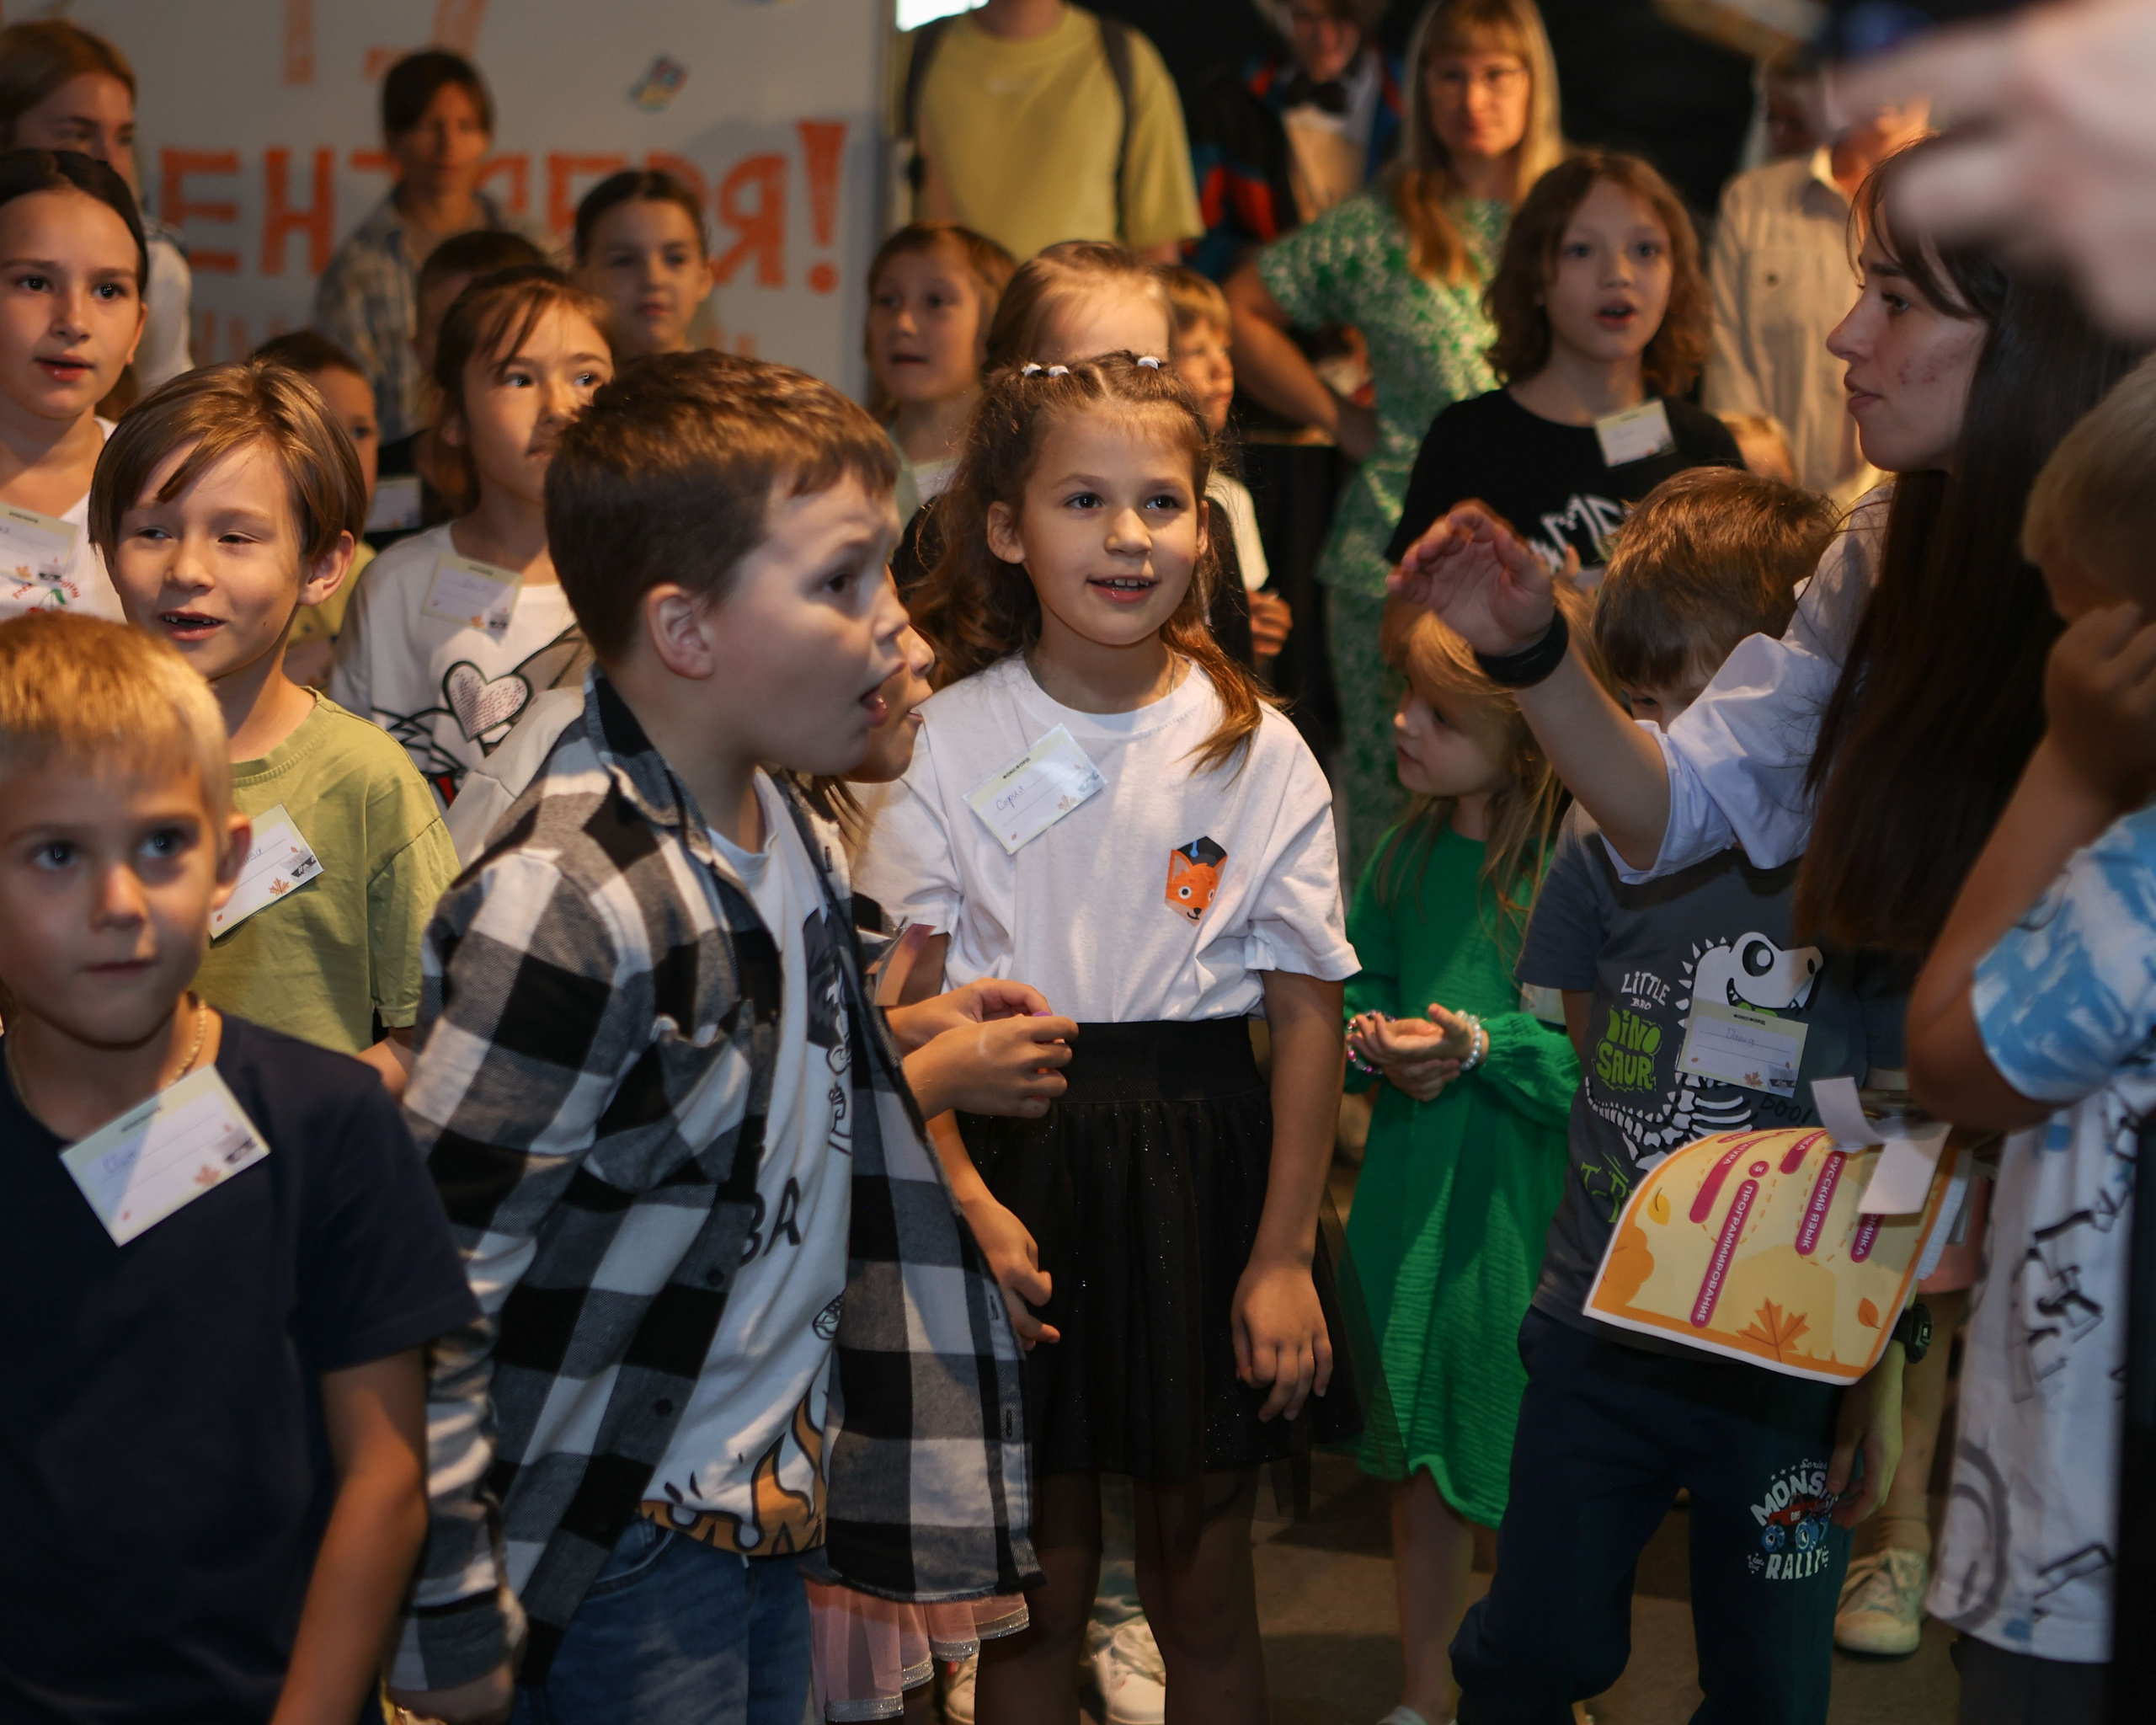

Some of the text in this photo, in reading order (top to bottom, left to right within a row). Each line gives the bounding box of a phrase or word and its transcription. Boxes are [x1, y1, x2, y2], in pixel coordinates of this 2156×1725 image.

[1597, 1043, 1652, 1089] SAUR
[1801, 1156, 1841, 1250] РУССКИЙ ЯЗЫК
[1696, 1185, 1754, 1322] ПРОГРАММИРОВАНИЕ
[1765, 1546, 1824, 1579] RALLY
